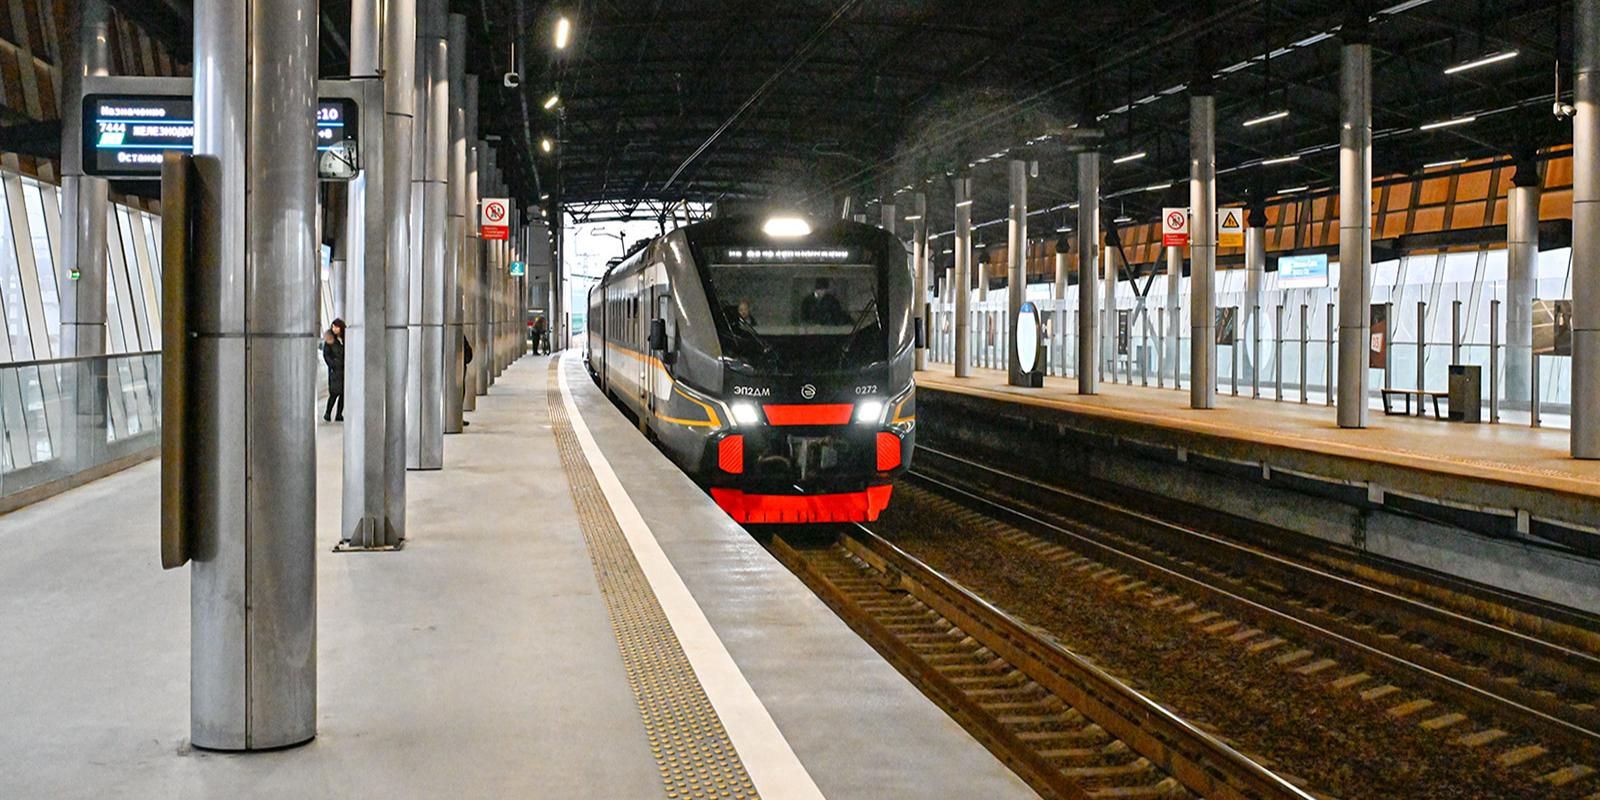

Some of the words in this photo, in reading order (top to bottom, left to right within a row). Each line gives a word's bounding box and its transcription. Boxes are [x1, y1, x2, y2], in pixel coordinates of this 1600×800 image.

[99, 123, 126, 132] 7444
[734, 385, 771, 396] ЭП2ДМ
[855, 385, 878, 395] 0272
